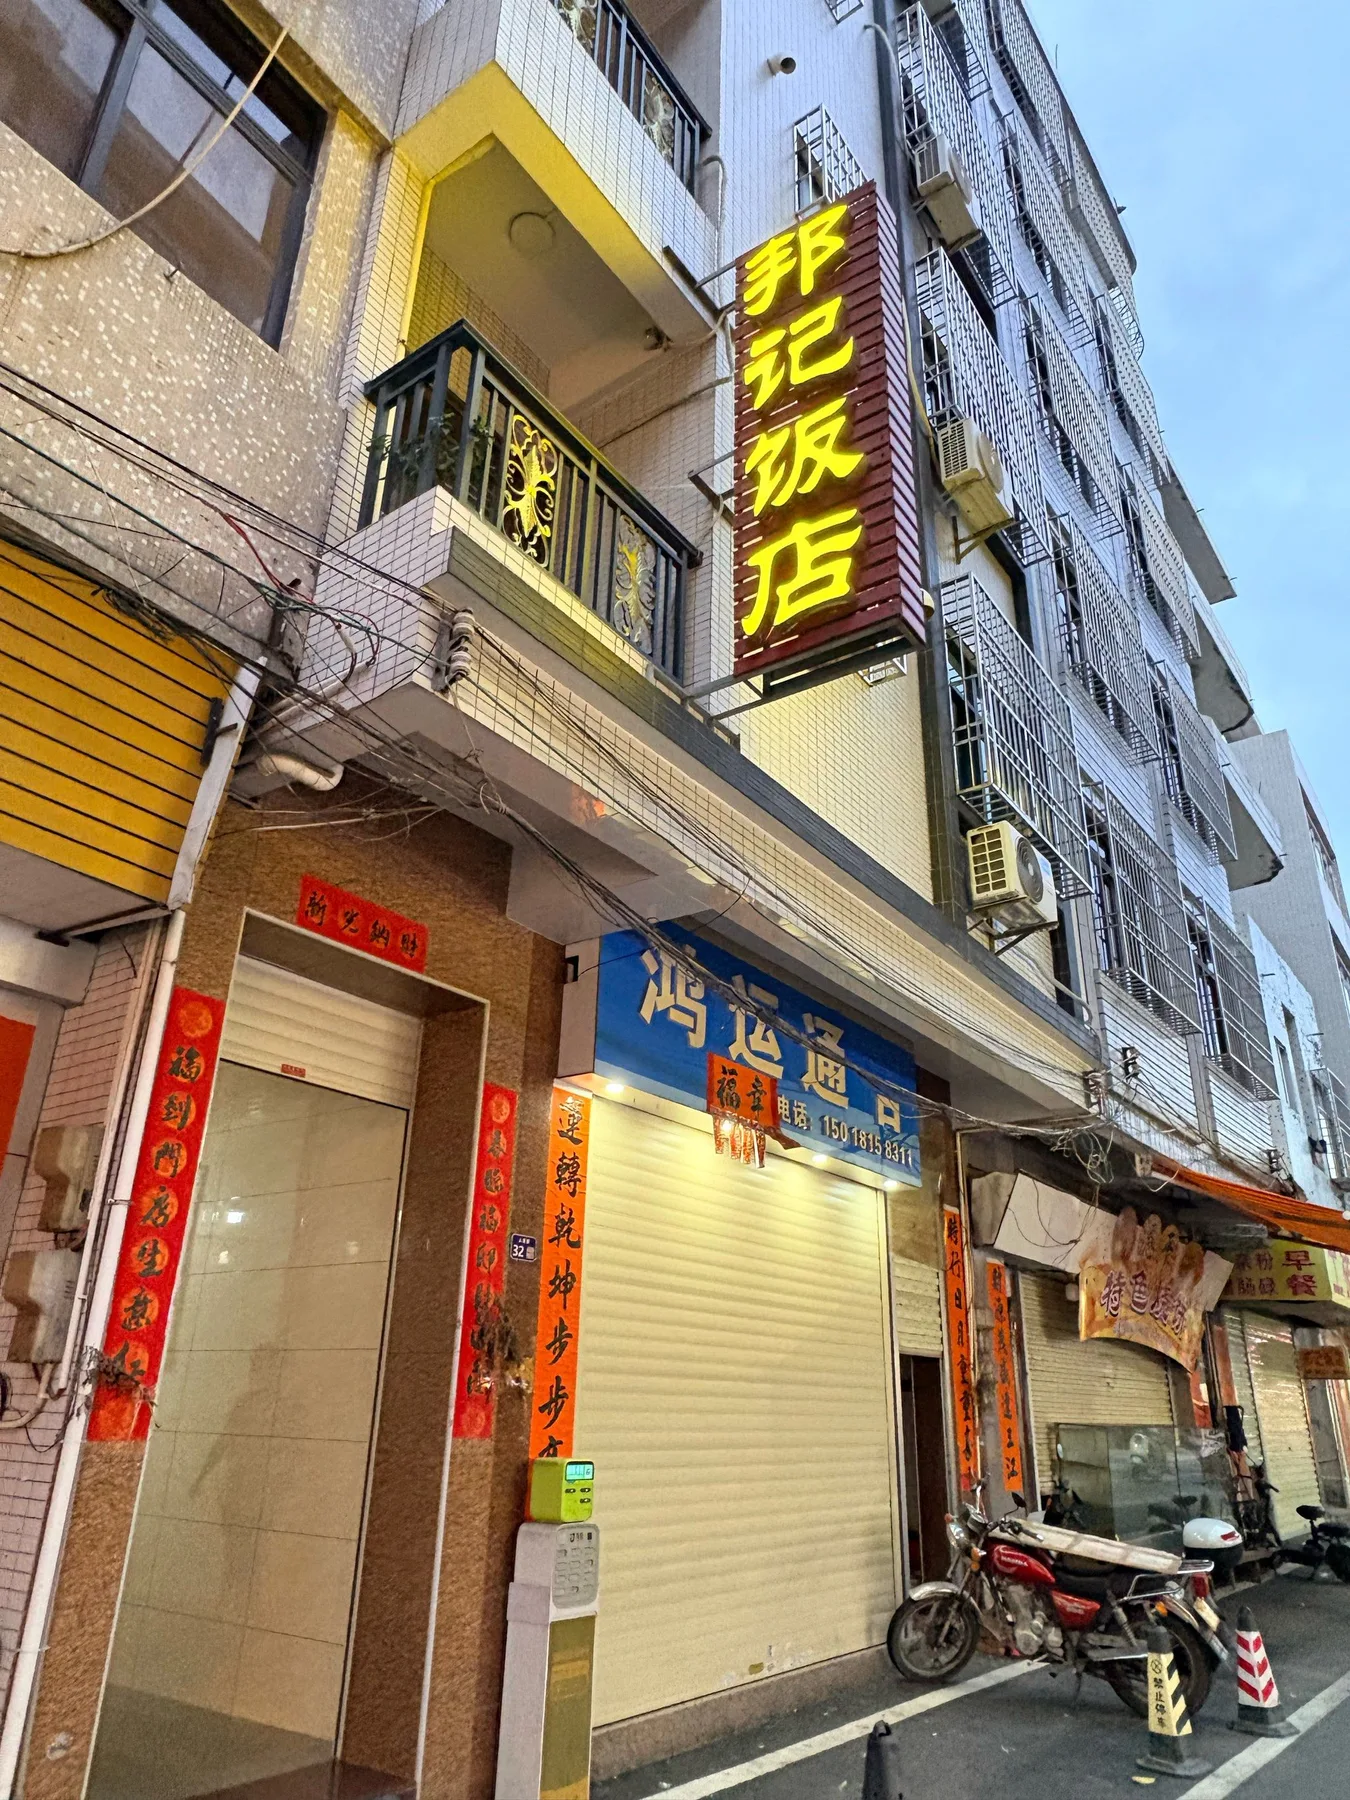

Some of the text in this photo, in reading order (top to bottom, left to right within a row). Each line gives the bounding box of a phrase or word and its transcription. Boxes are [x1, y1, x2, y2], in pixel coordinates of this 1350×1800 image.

[741, 204, 867, 637] 邦记饭店
[824, 1115, 848, 1141] 150
[852, 1126, 881, 1156] 1815
[885, 1139, 913, 1168] 8311
[512, 1244, 525, 1258] 32
[1282, 1250, 1318, 1296] 早餐
